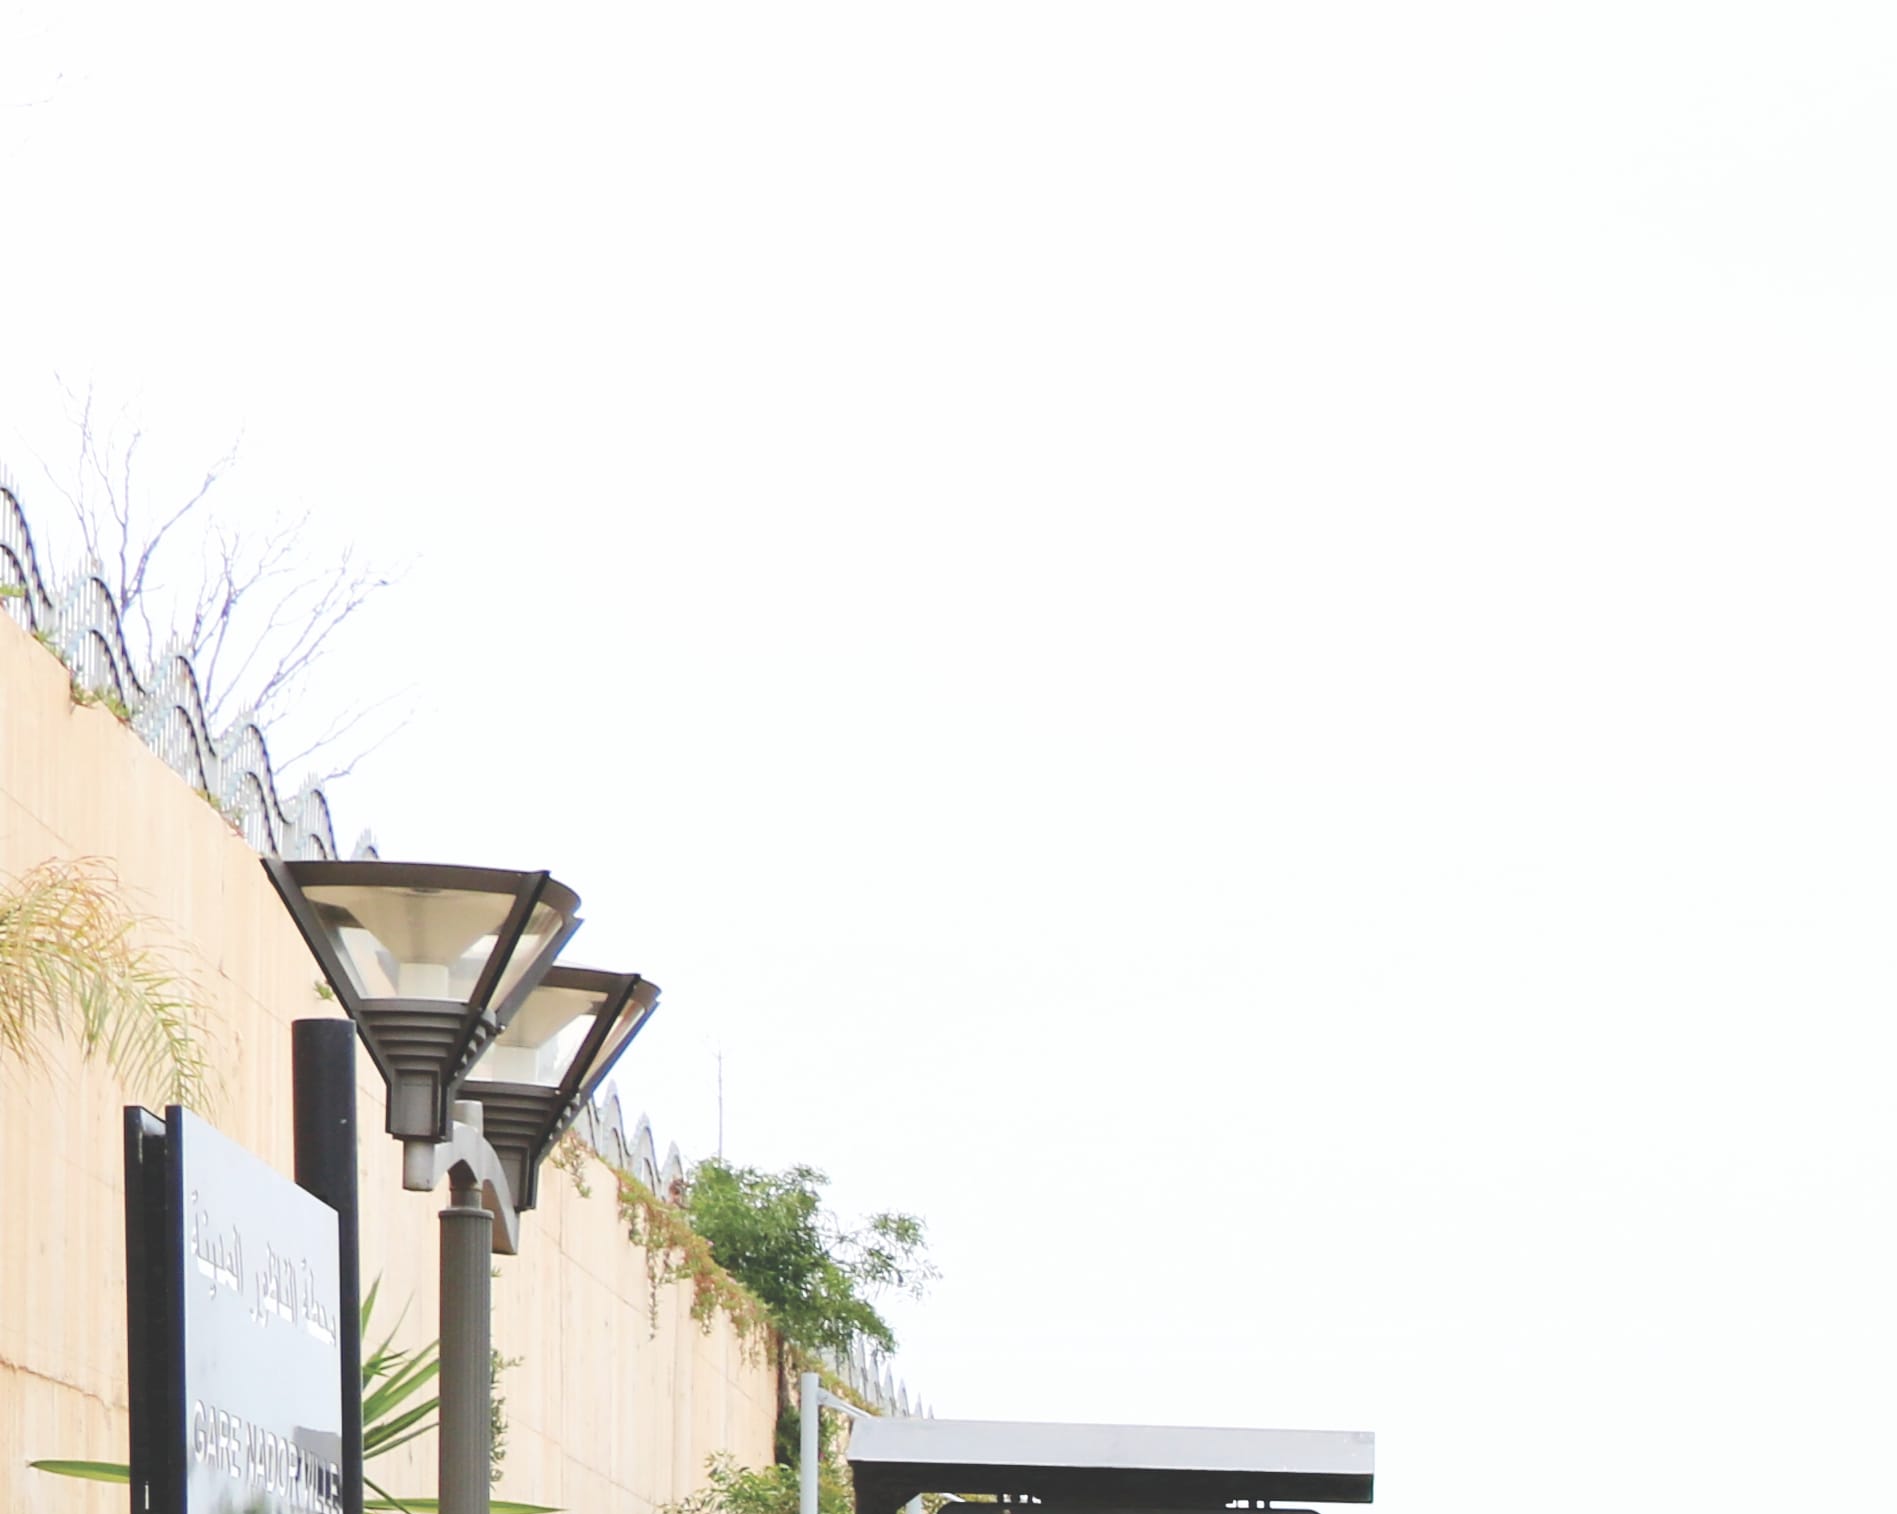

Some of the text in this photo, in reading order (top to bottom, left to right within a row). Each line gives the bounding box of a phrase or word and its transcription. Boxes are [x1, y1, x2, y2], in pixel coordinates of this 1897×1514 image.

[303, 1257, 338, 1347] محطة
[193, 1399, 242, 1478] GARE
[244, 1421, 300, 1508] NADOR
